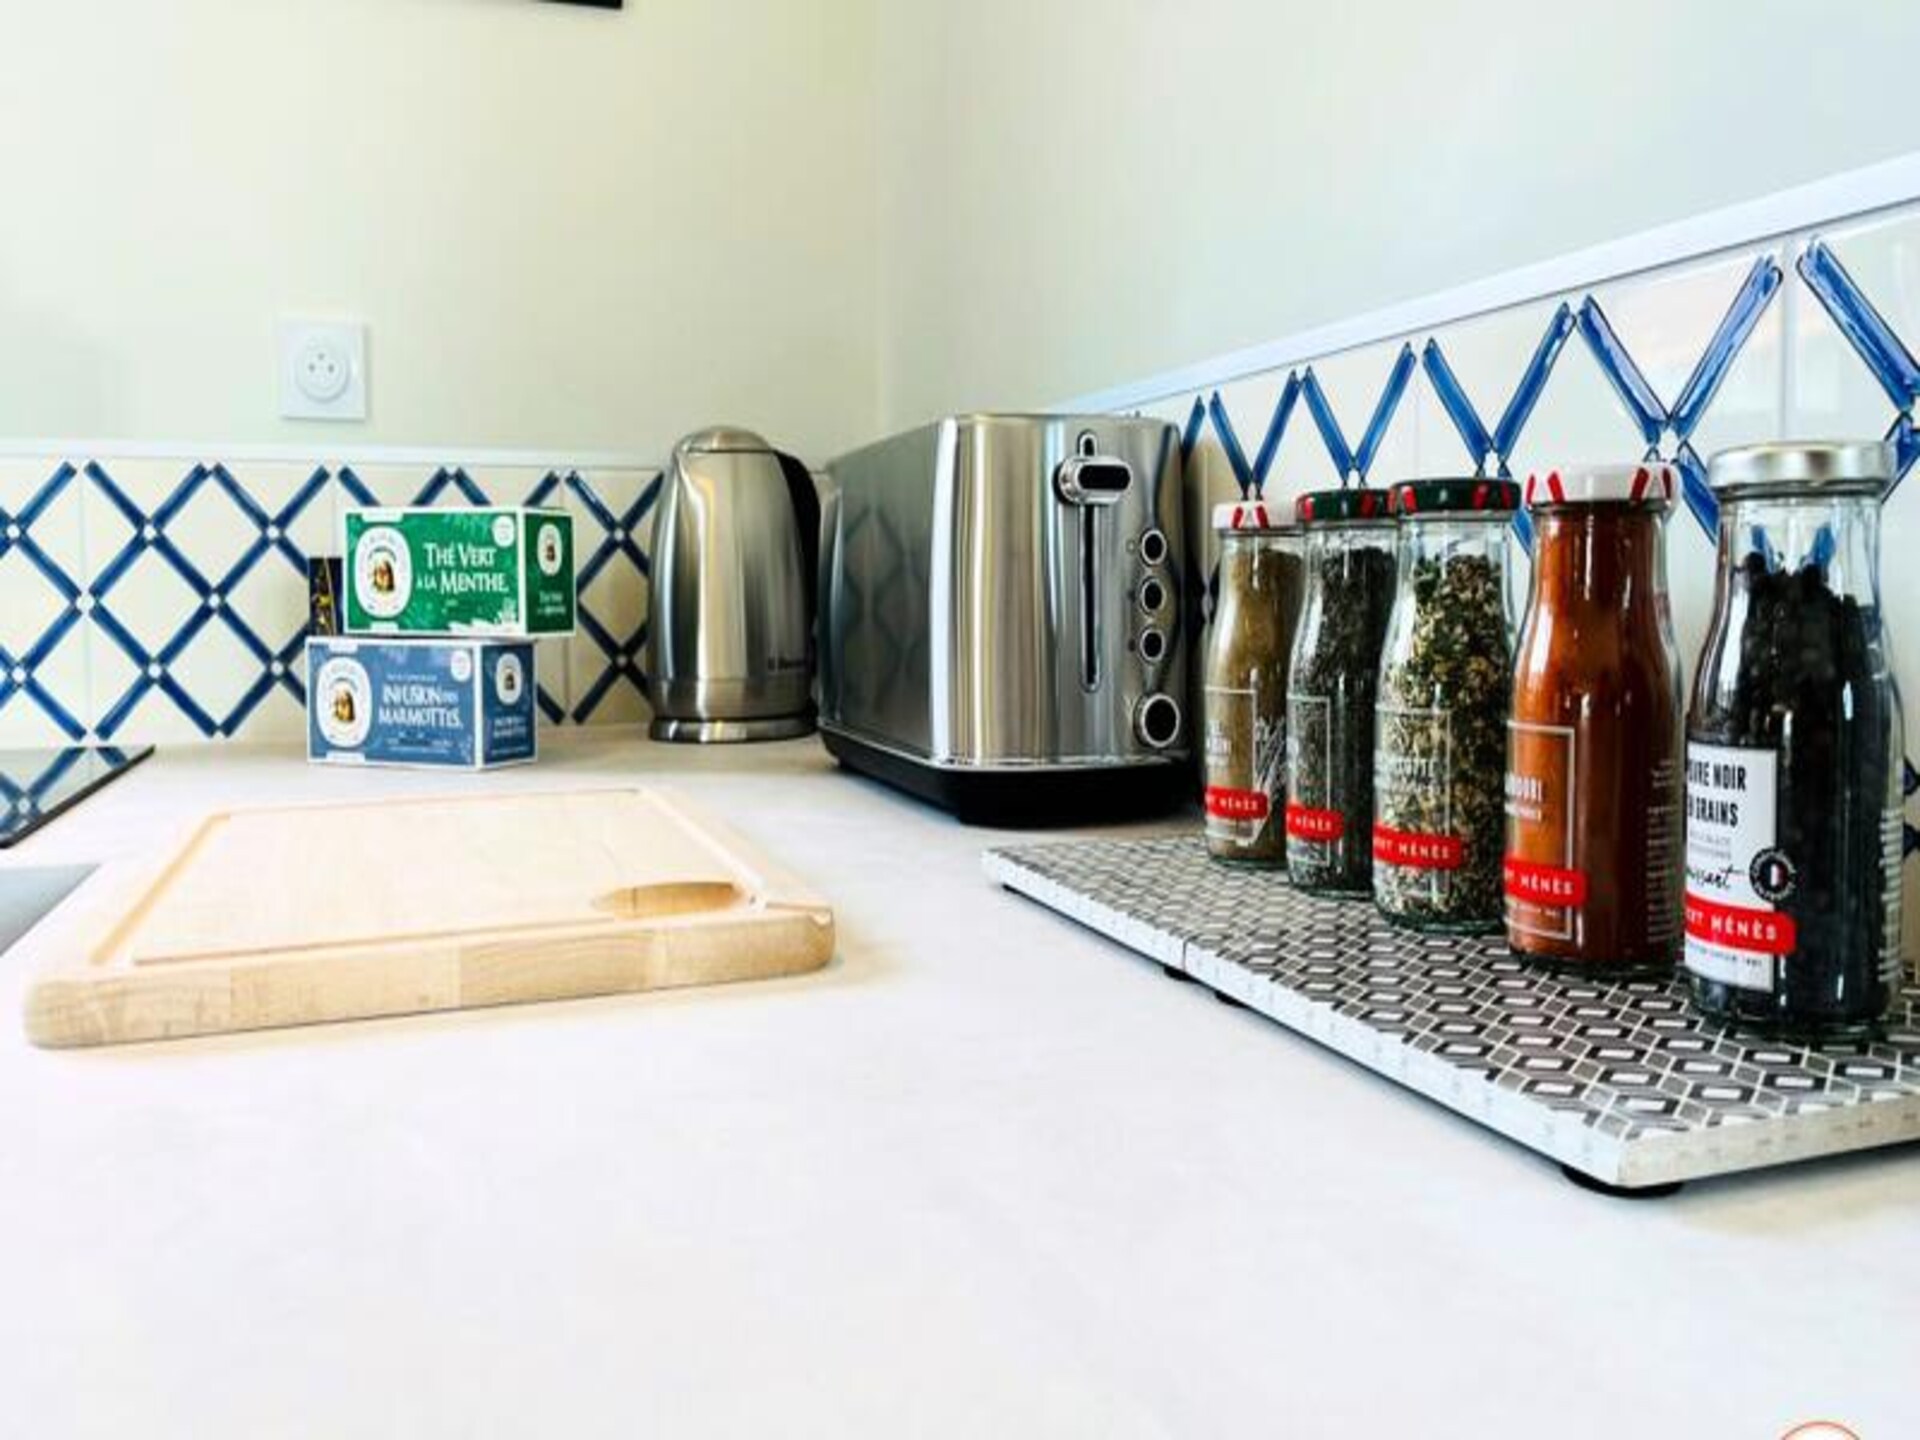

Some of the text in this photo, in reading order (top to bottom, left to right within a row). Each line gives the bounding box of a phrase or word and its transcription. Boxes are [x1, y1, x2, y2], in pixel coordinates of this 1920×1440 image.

[422, 540, 497, 571] THÉ VERT
[424, 574, 437, 591] LA
[440, 570, 510, 596] MENTHE
[1713, 763, 1747, 792] NOIR
[1710, 913, 1777, 941] MÉNÈS
